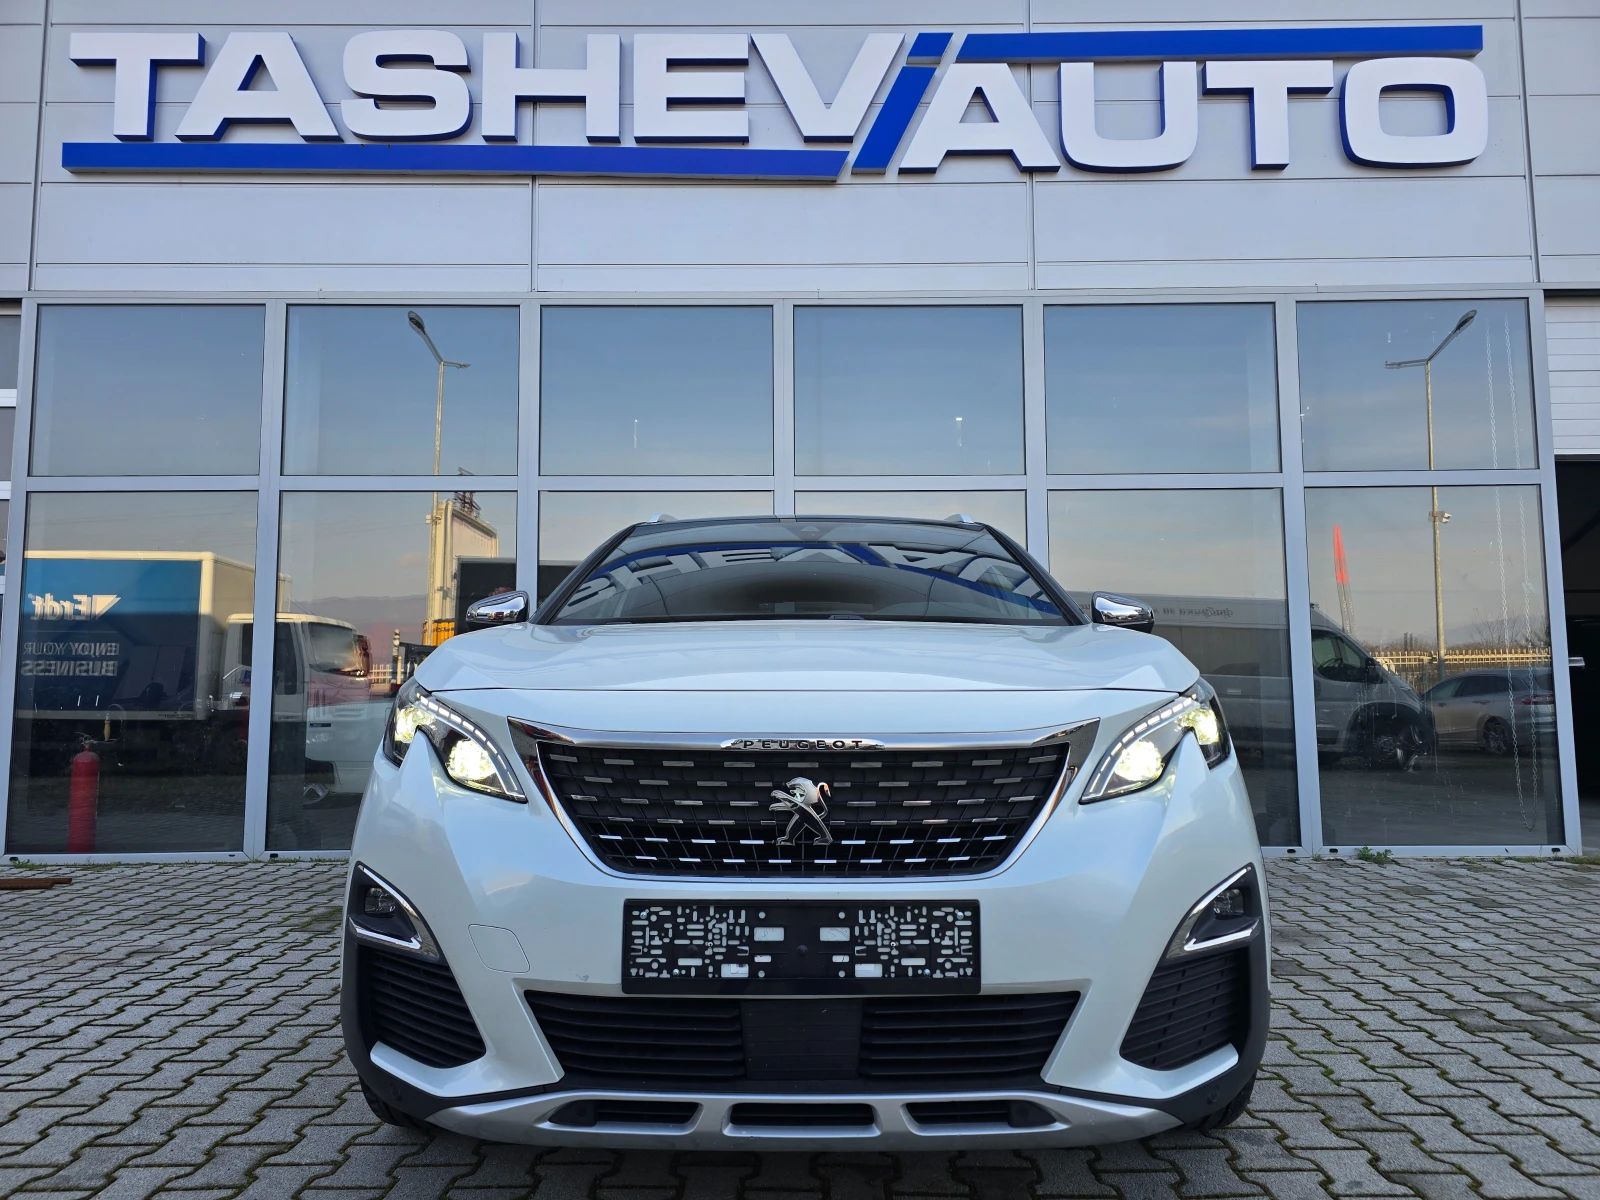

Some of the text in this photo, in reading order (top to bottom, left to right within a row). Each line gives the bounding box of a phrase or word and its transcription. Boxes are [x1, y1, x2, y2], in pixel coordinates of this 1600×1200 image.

[69, 29, 1489, 174] TASHEV AUTO
[743, 739, 863, 750] PEUGEOT
